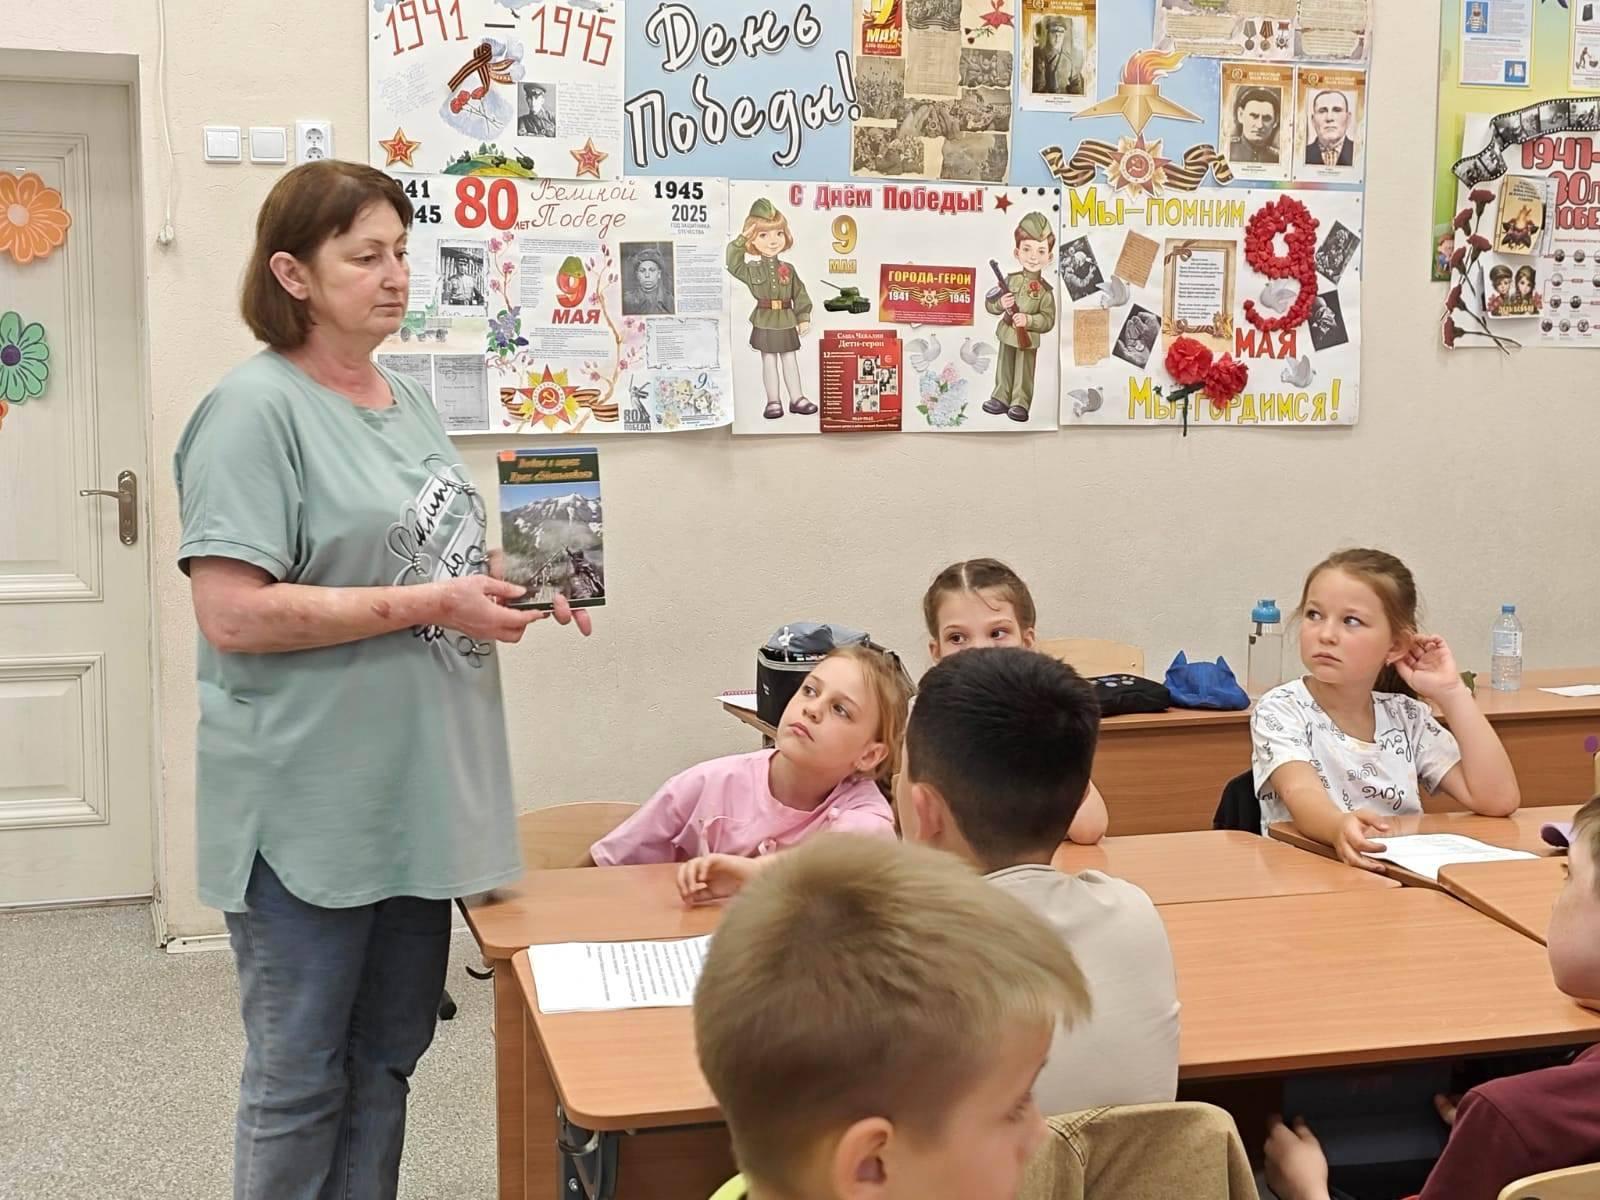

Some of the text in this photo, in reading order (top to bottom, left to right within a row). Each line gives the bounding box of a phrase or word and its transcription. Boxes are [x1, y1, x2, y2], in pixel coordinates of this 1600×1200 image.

[386, 0, 468, 56] 1941
[531, 4, 616, 66] 1945
[645, 2, 822, 73] День
[624, 50, 862, 169] Победы!
[455, 176, 519, 231] 80
[531, 177, 639, 201] Великой
[654, 180, 704, 200] 1945
[789, 184, 985, 215] С Днём Победы!
[531, 203, 627, 240] Победе
[671, 204, 708, 223] 2025
[831, 214, 859, 255] 9
[888, 270, 972, 285] ГОРОДА-ГЕРОИ
[1243, 194, 1320, 332] 9
[556, 256, 588, 309] 9
[888, 291, 971, 304] 1941 1945
[551, 309, 601, 325] МАЯ
[1235, 328, 1298, 360] МАЯ
